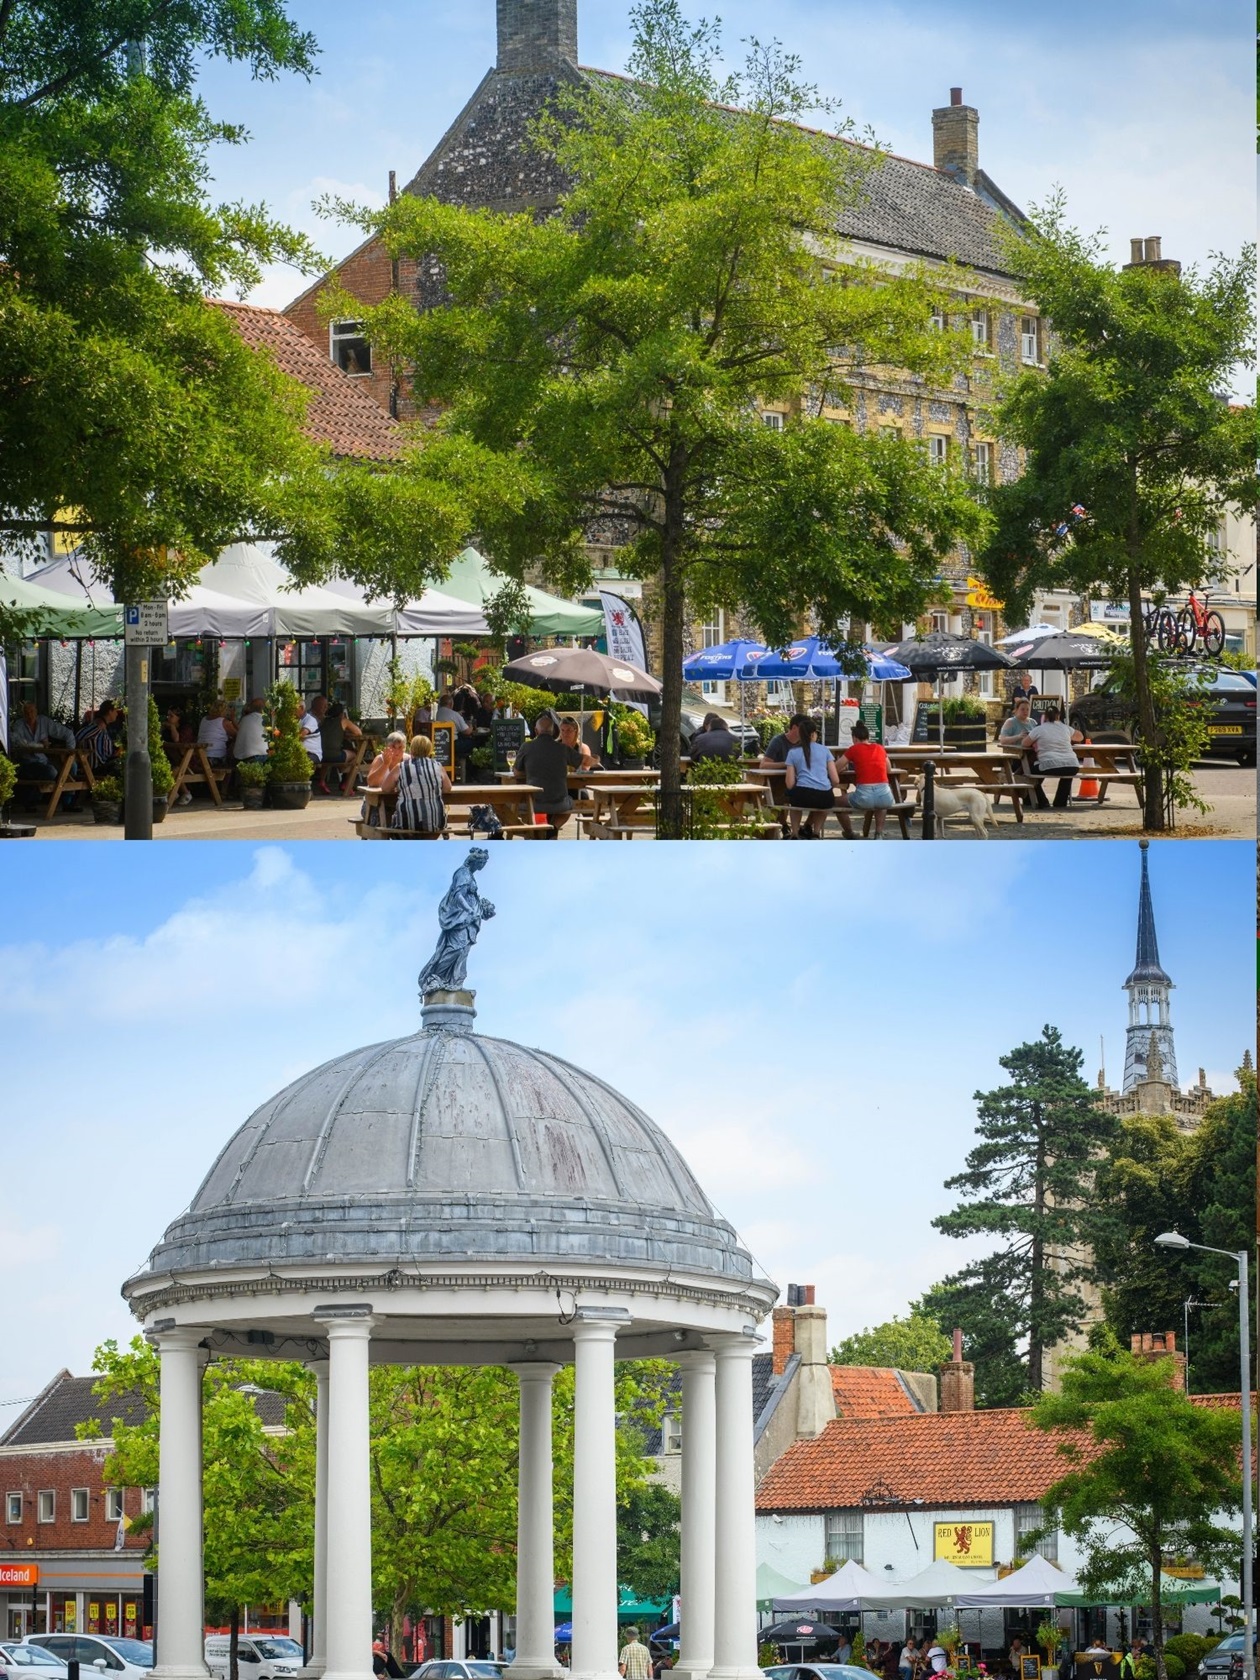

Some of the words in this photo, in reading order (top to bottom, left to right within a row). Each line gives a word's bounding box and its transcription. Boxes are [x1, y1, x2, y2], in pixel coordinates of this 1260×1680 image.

[130, 608, 137, 623] P
[938, 1528, 951, 1538] RED
[974, 1527, 991, 1537] LION
[0, 1569, 29, 1581] Iceland
